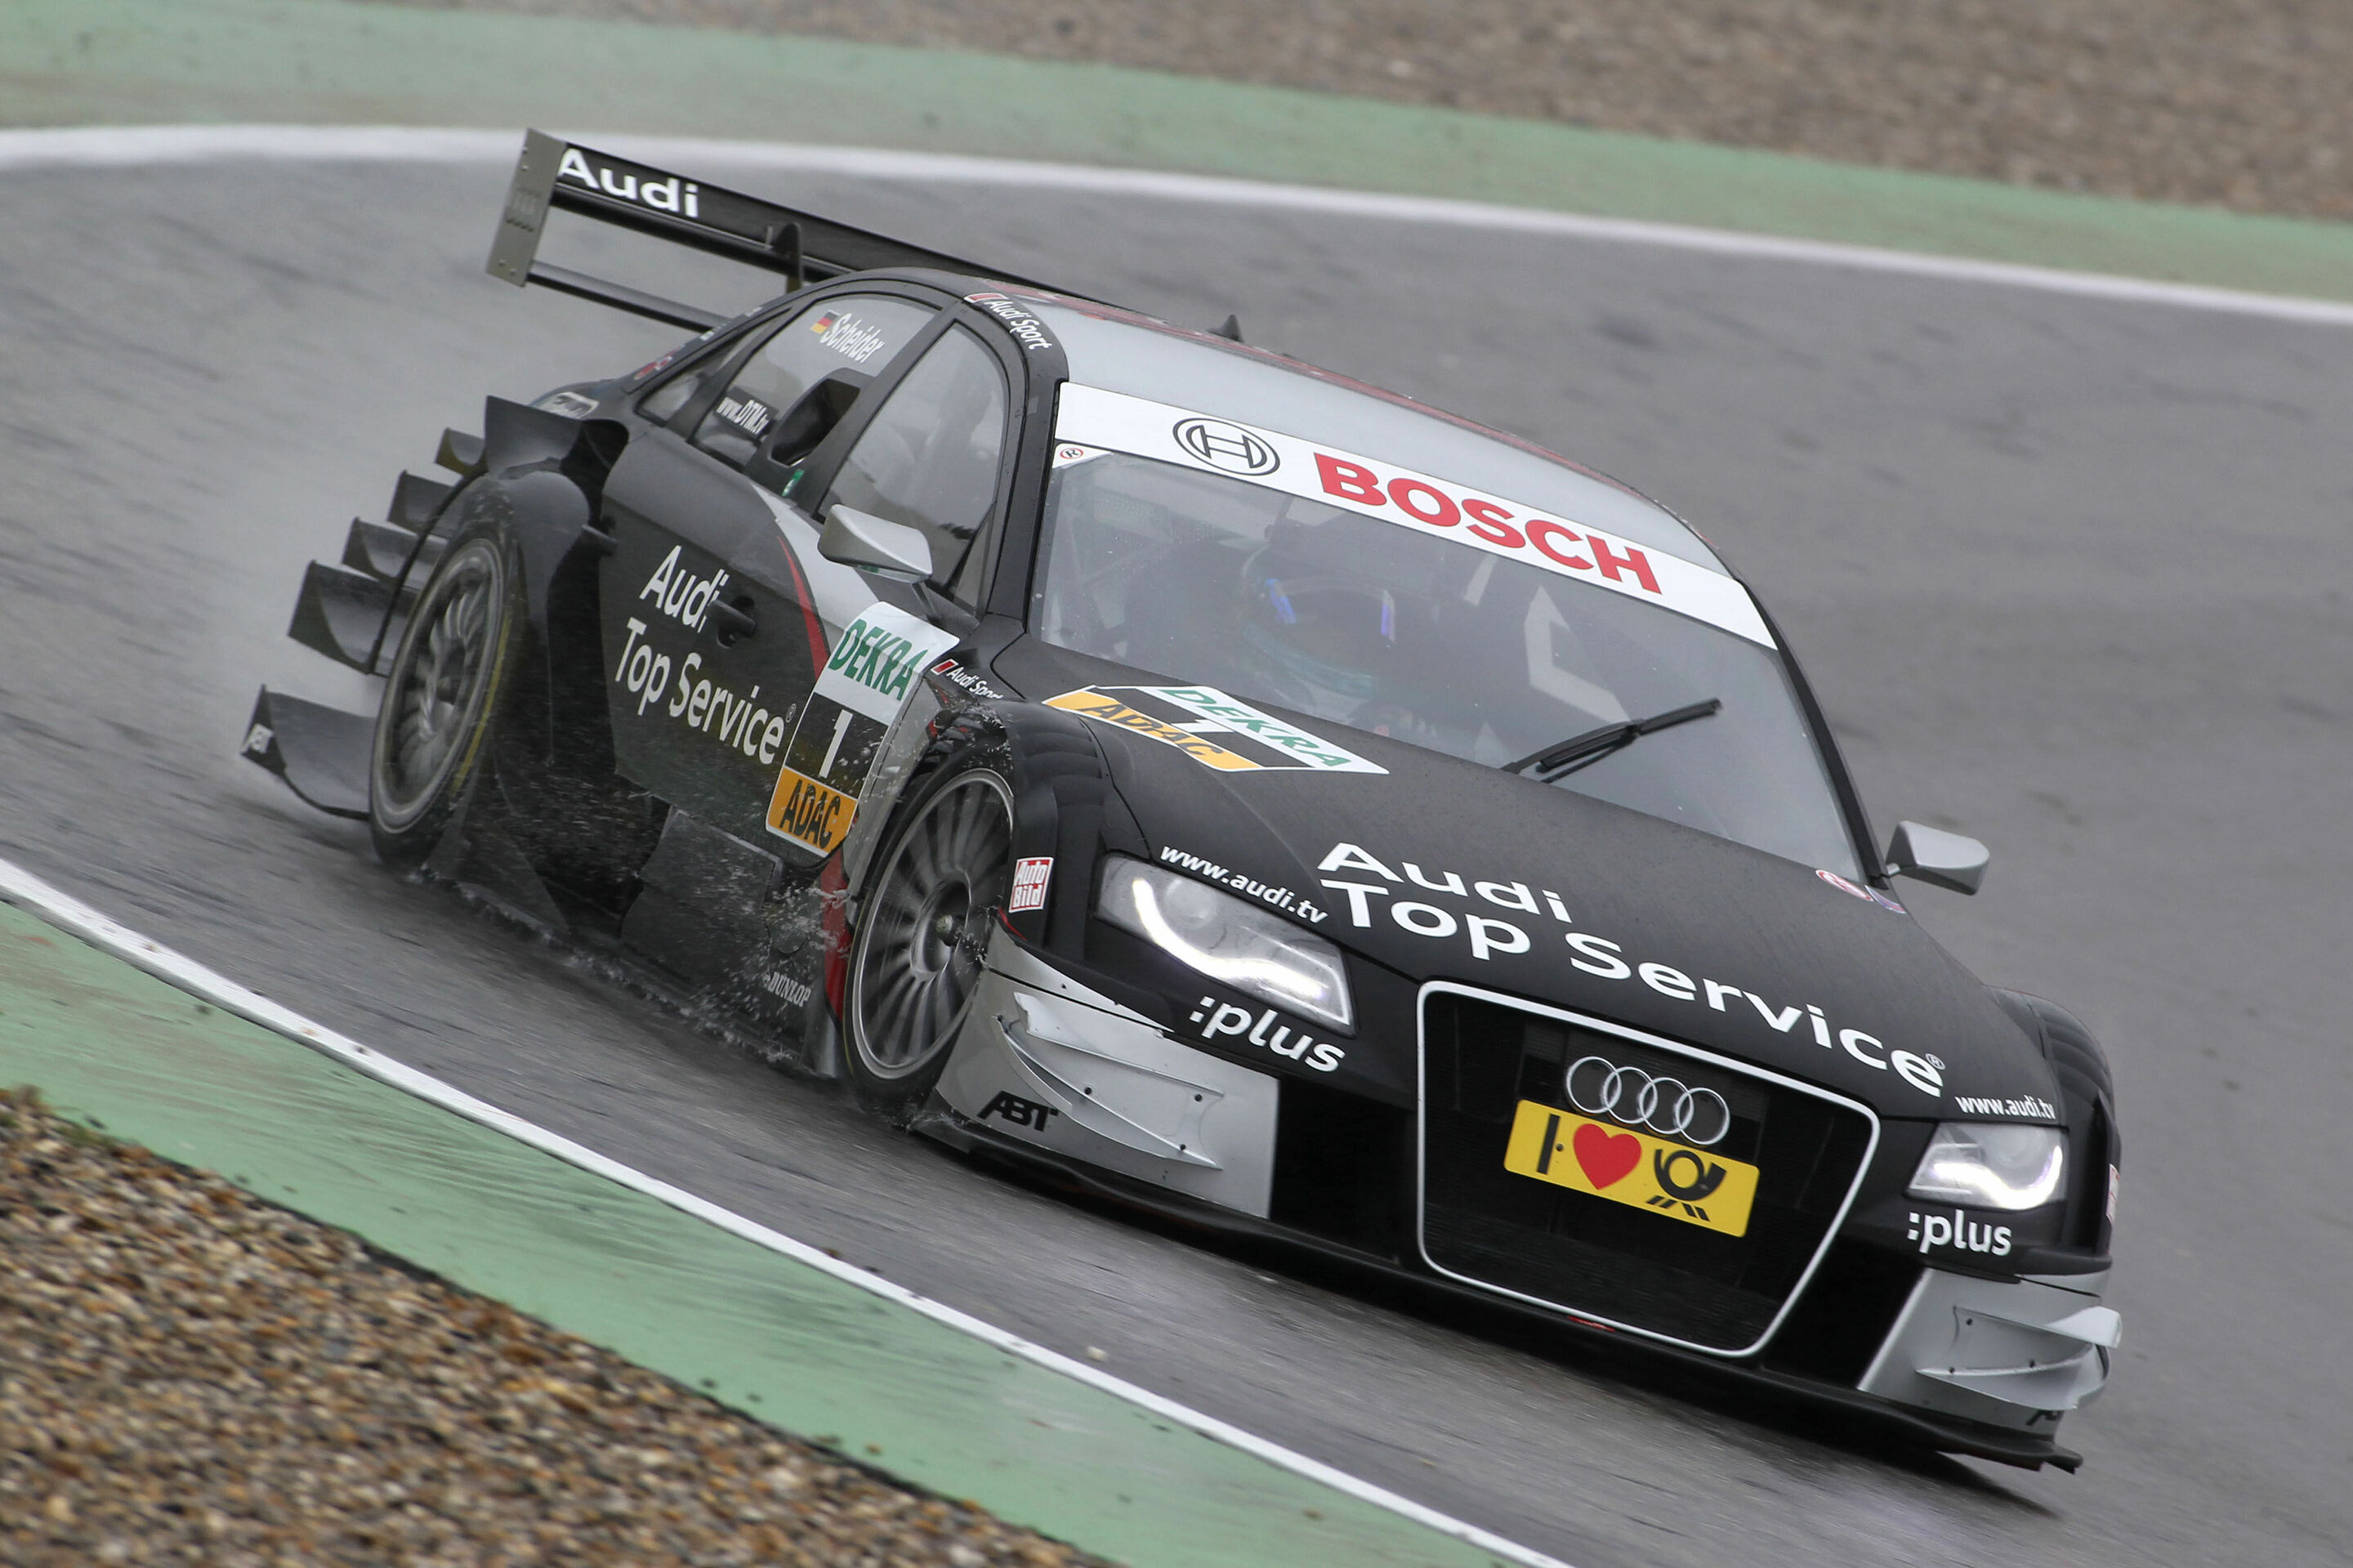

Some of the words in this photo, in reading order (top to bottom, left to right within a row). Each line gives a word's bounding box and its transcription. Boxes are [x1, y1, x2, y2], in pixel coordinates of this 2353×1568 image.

[557, 148, 699, 218] Audi
[819, 312, 886, 364] Scheider
[984, 300, 1033, 320] Audi
[1009, 319, 1053, 351] Sport
[1314, 452, 1663, 595] BOSCH
[639, 544, 730, 634] Audi
[615, 616, 671, 717] Top
[827, 619, 929, 701] DEKRA
[946, 666, 980, 689] Audi
[818, 708, 854, 779] 1
[1077, 704, 1225, 757] ADAC
[1158, 689, 1353, 767] DEKRA
[779, 779, 841, 850] ADAC
[1012, 884, 1044, 909] Bild
[1013, 860, 1048, 887] Auto
[1160, 846, 1328, 925] www.audi.tv
[1317, 842, 1573, 923] Audi
[1319, 879, 1531, 961] Top
[767, 972, 812, 1007] DUNLOP
[1189, 996, 1346, 1073] :plus
[978, 1091, 1059, 1132] ABT
[1954, 1094, 2056, 1119] www.audi.tv
[1537, 1113, 1560, 1175] I
[1907, 1209, 2012, 1256] :plus
